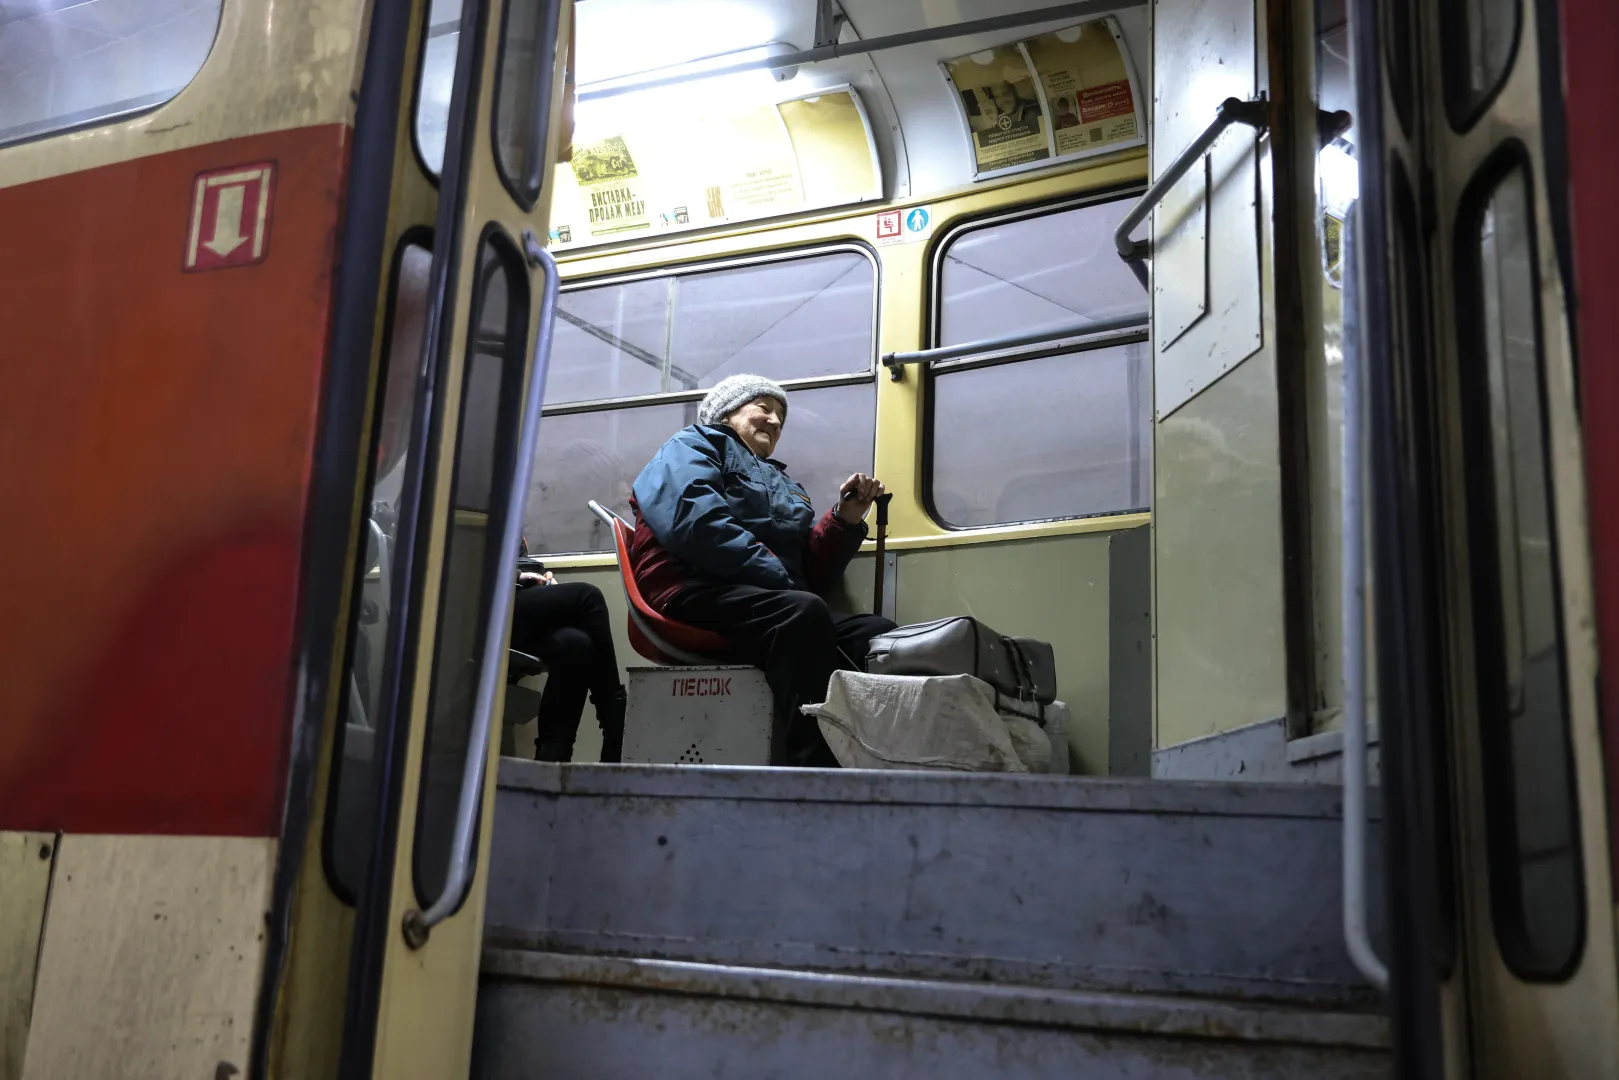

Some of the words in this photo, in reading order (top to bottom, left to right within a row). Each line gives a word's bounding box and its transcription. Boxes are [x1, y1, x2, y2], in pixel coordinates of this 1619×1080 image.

[591, 187, 636, 207] ВИСТАВКА-
[589, 203, 623, 223] ПРОДАЖ
[624, 200, 645, 217] МЕДУ
[672, 677, 732, 697] ПЕСОК
